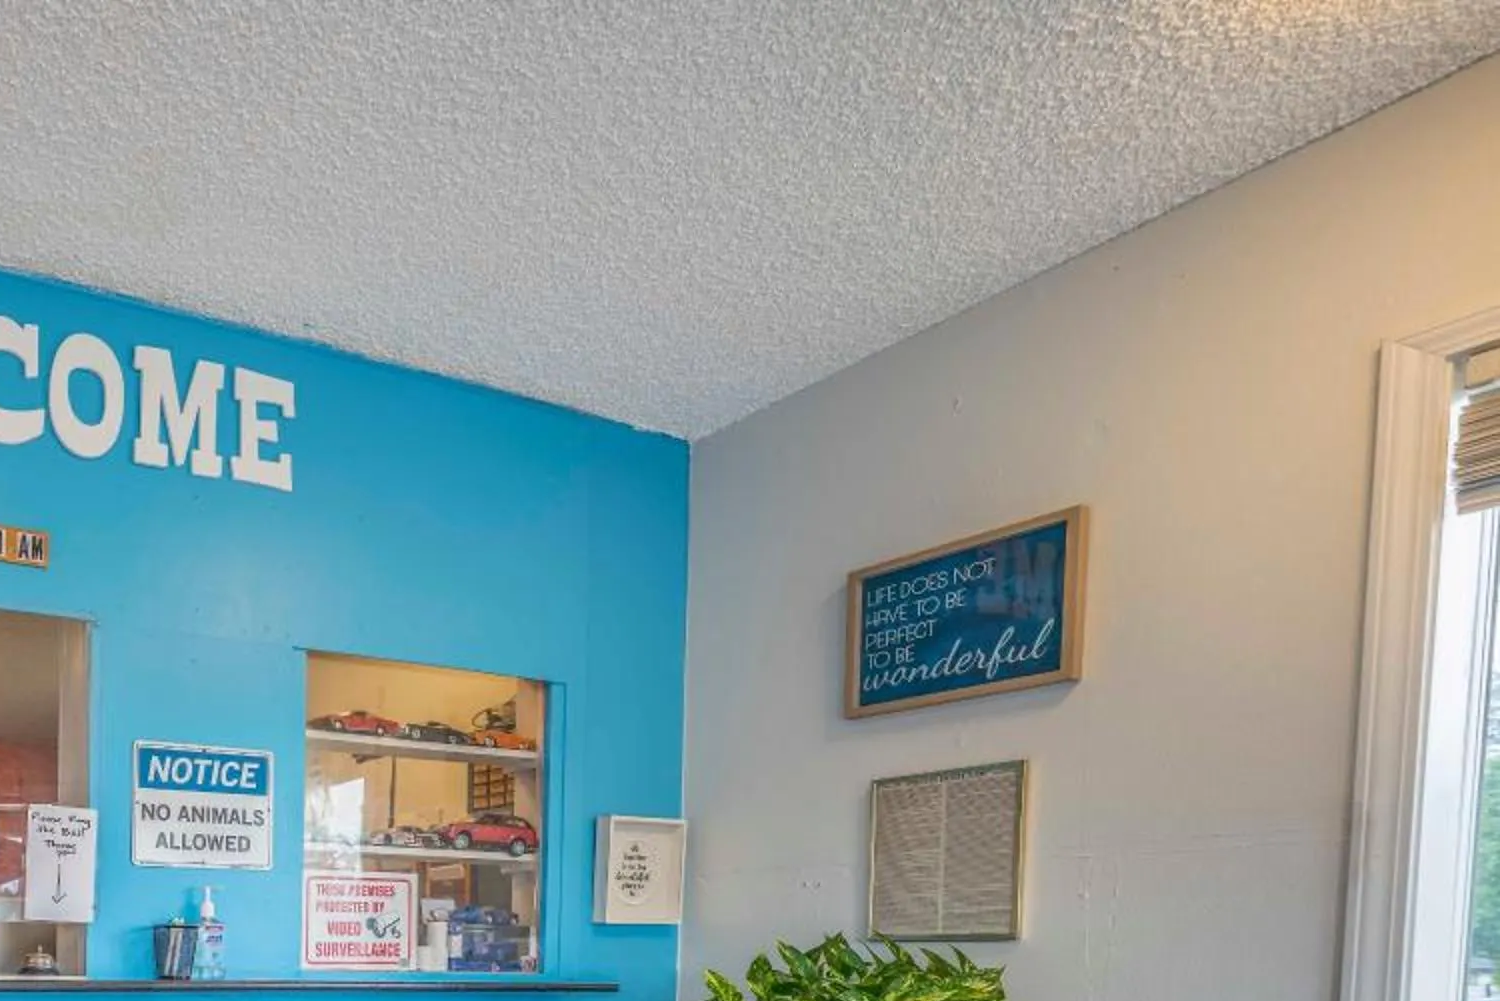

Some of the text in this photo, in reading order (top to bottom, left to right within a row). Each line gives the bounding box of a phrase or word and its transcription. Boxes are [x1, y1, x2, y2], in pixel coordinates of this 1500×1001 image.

[18, 534, 43, 561] AM
[867, 557, 997, 608] LIFE DOES NOT
[866, 587, 967, 629] HAVE TO BE
[865, 618, 938, 651] PERFECT
[863, 617, 1055, 692] wonderful
[867, 642, 915, 670] TO BE
[147, 754, 261, 789] NOTICE
[140, 802, 265, 827] NO ANIMALS
[155, 831, 252, 853] ALLOWED
[327, 921, 362, 936] VIDEO
[315, 941, 401, 957] SURVEILLANCE
